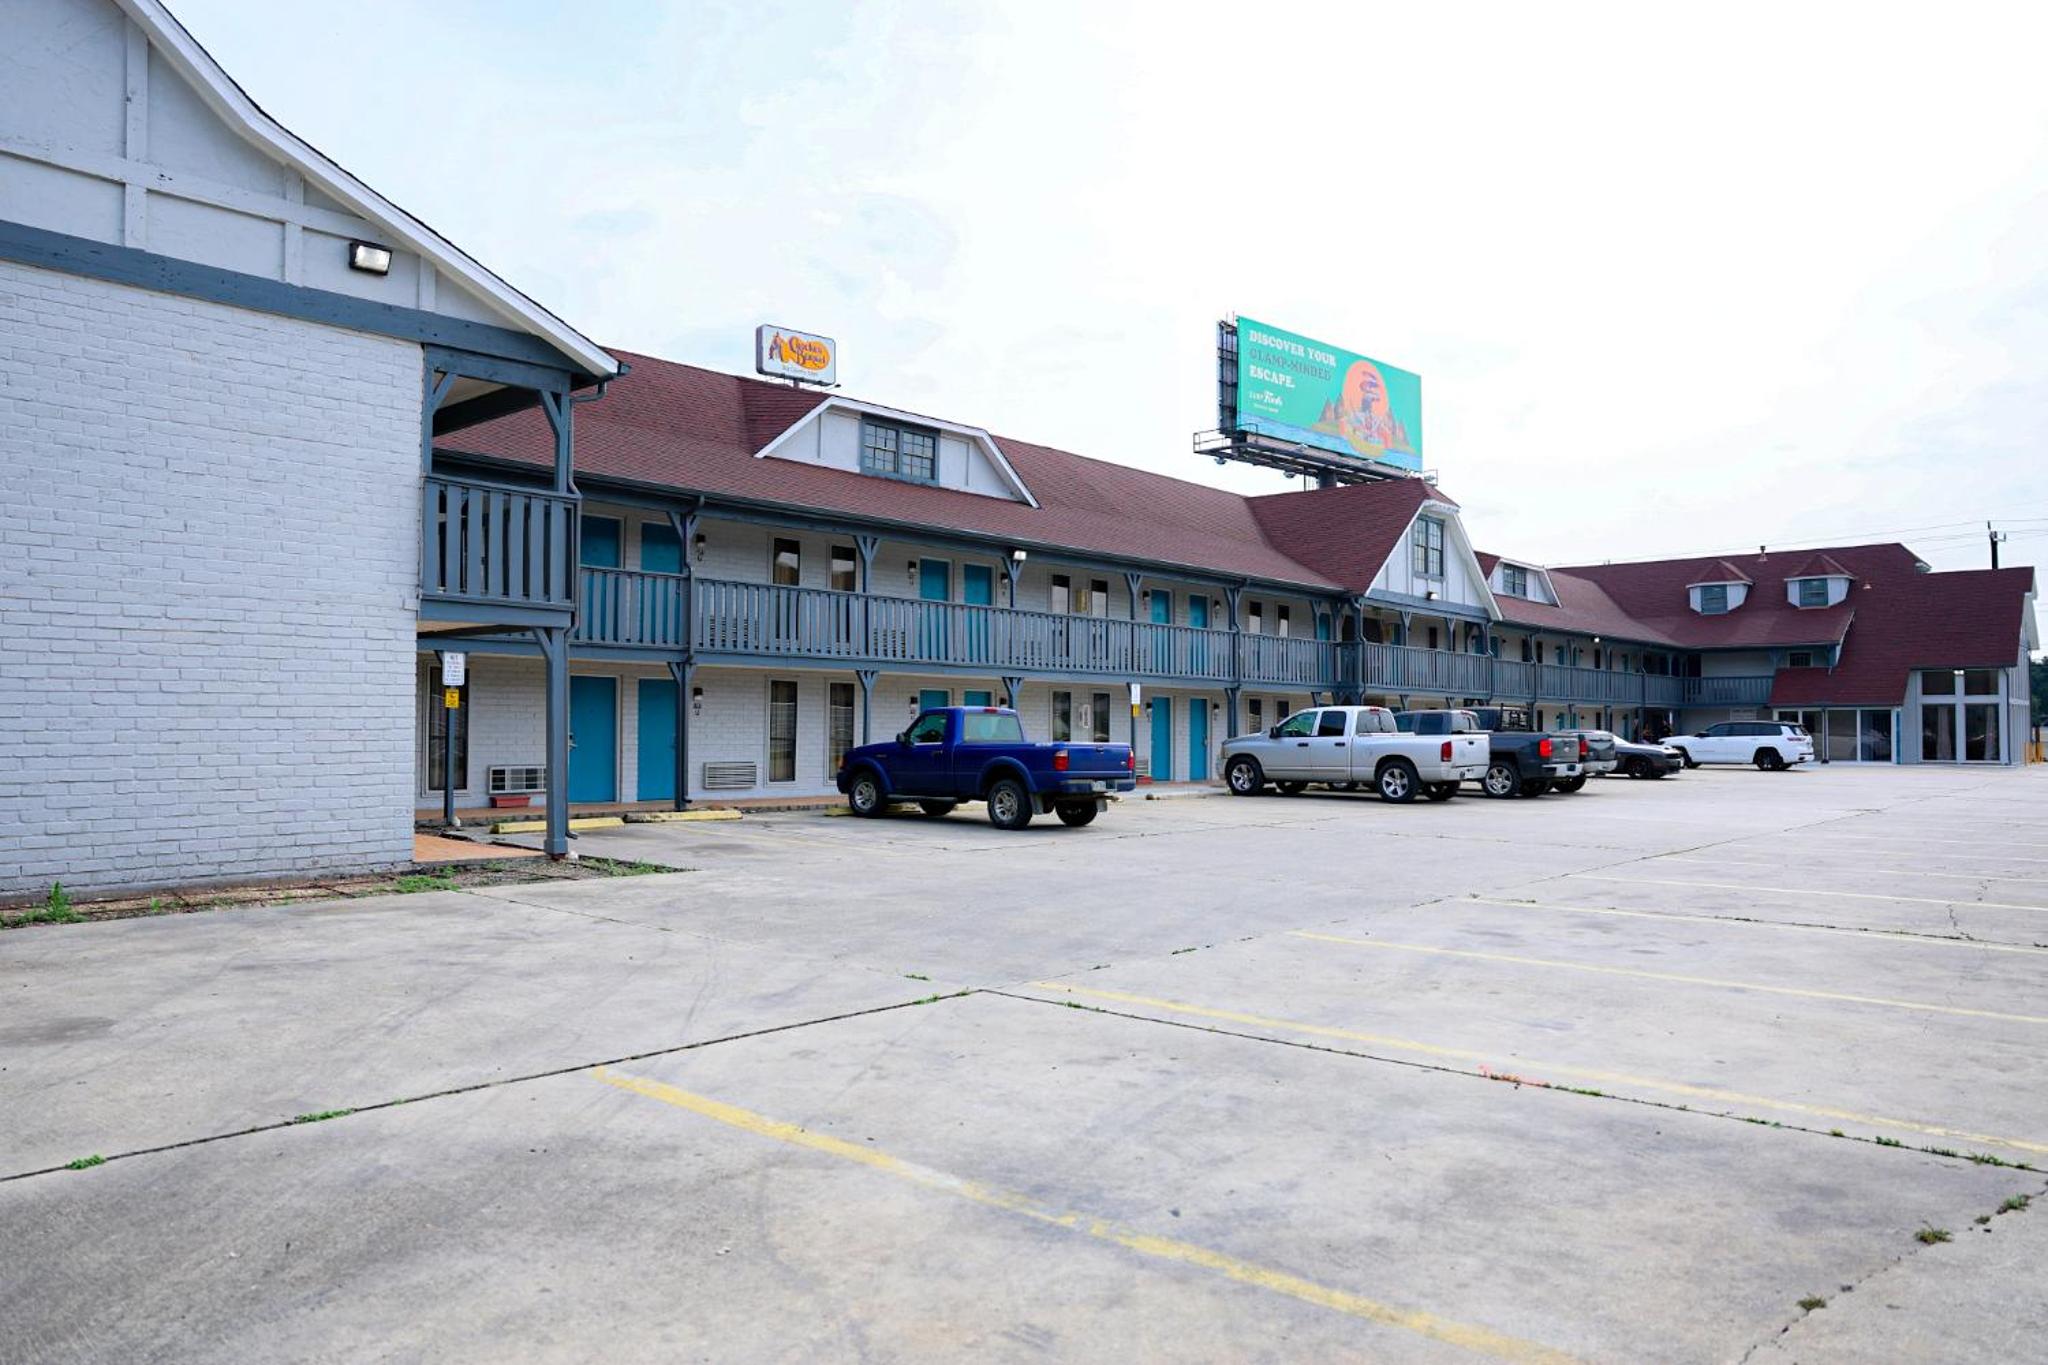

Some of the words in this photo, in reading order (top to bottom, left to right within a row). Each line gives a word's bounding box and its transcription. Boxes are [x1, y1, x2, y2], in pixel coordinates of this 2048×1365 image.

[1249, 330, 1305, 357] DISCOVER
[1308, 347, 1336, 367] YOUR
[1249, 365, 1295, 388] ESCAPE.
